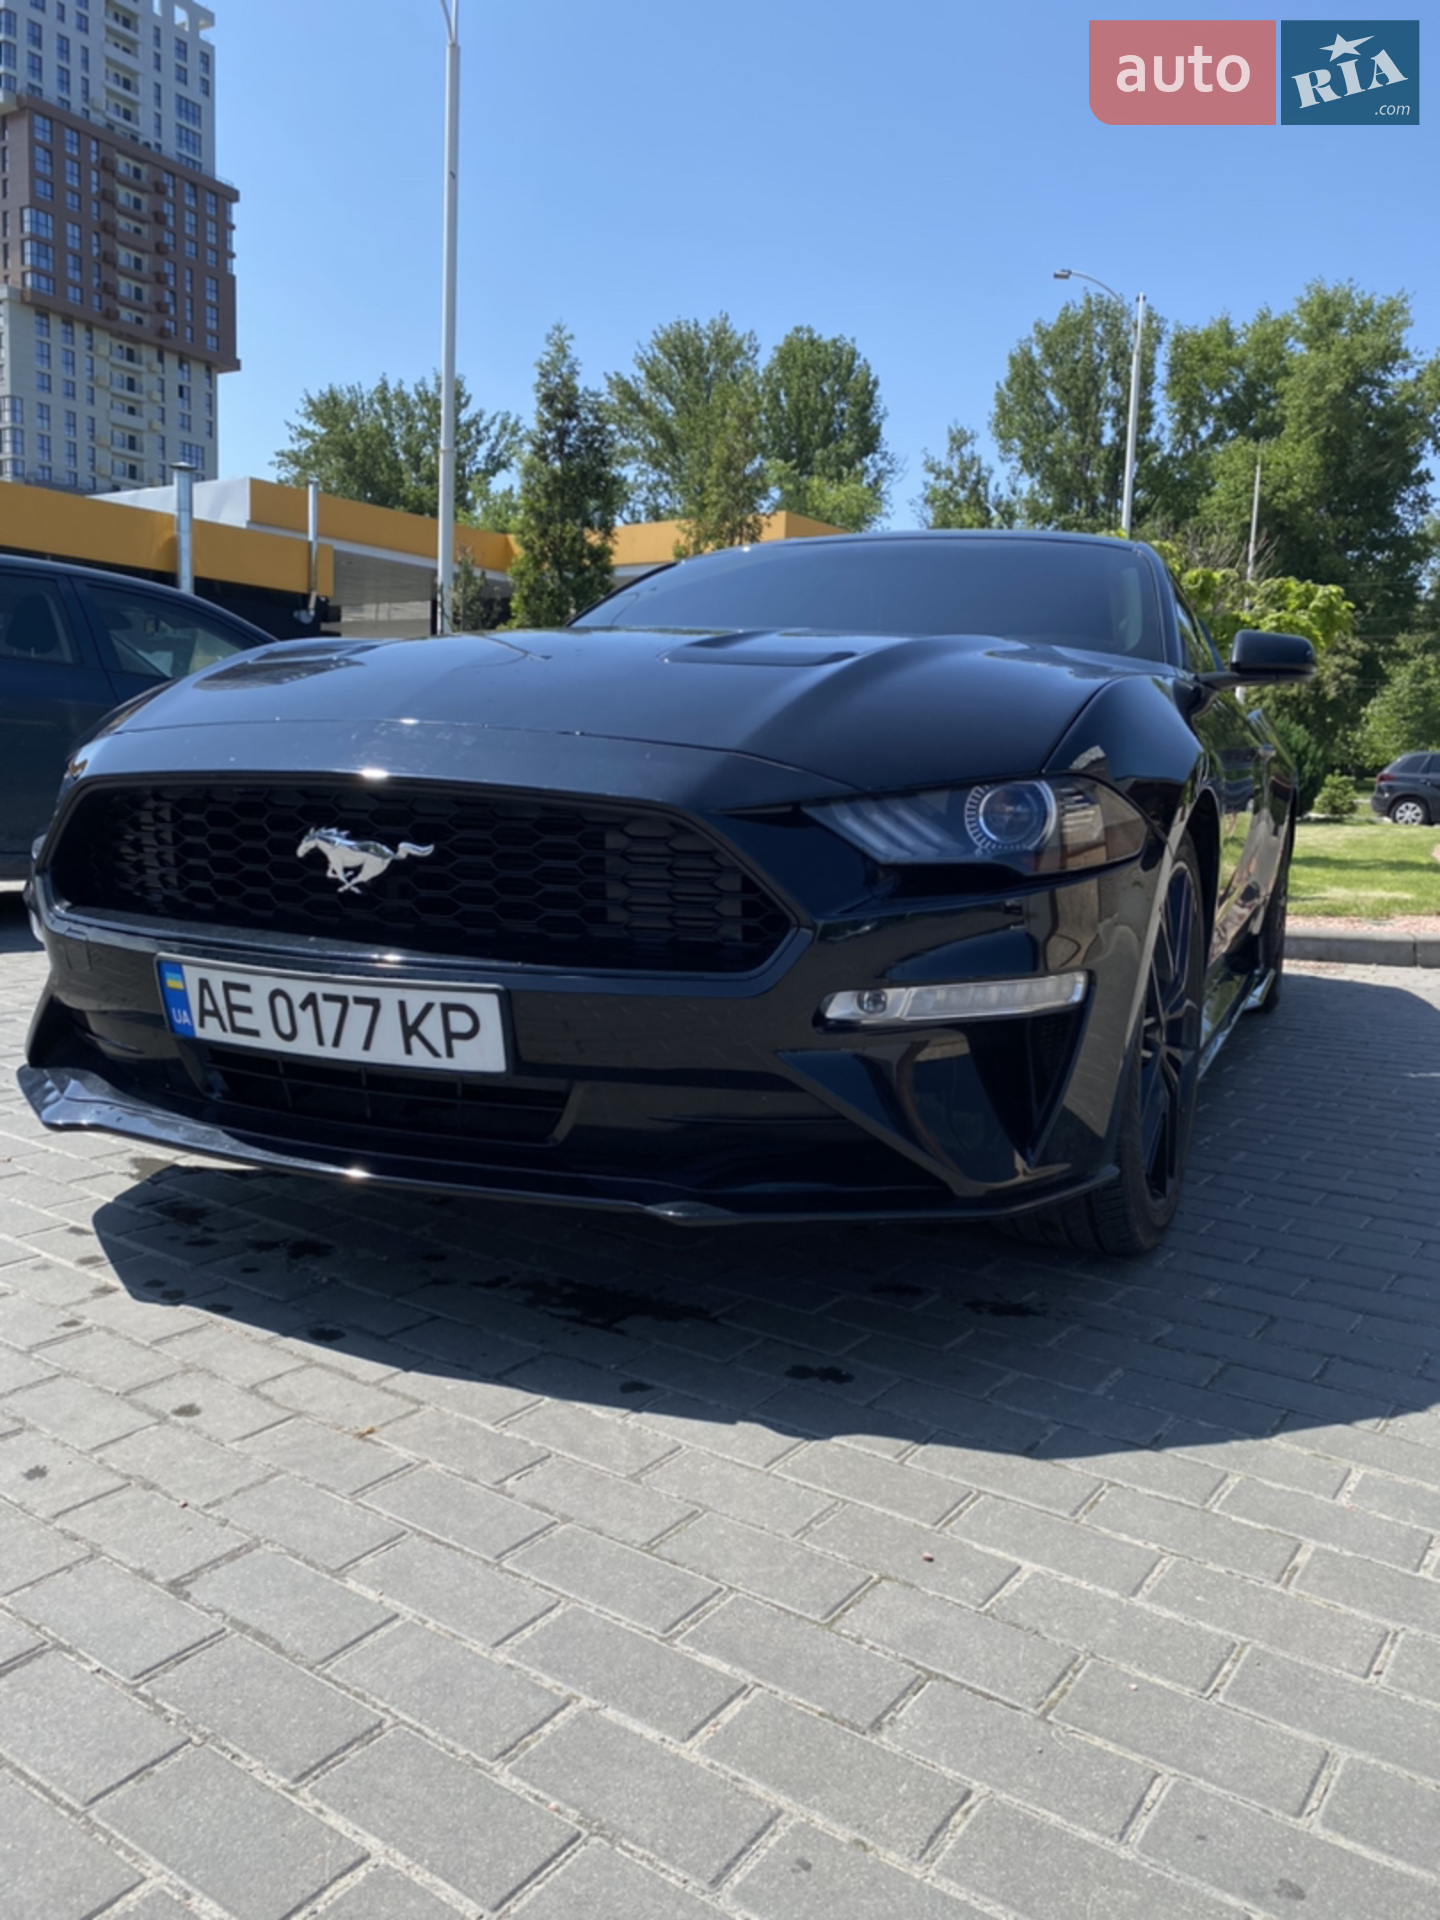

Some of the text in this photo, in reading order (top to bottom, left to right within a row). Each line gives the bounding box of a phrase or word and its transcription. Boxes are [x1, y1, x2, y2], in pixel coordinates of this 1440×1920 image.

[171, 1007, 192, 1026] UA
[197, 977, 481, 1059] AE 0177 KP
